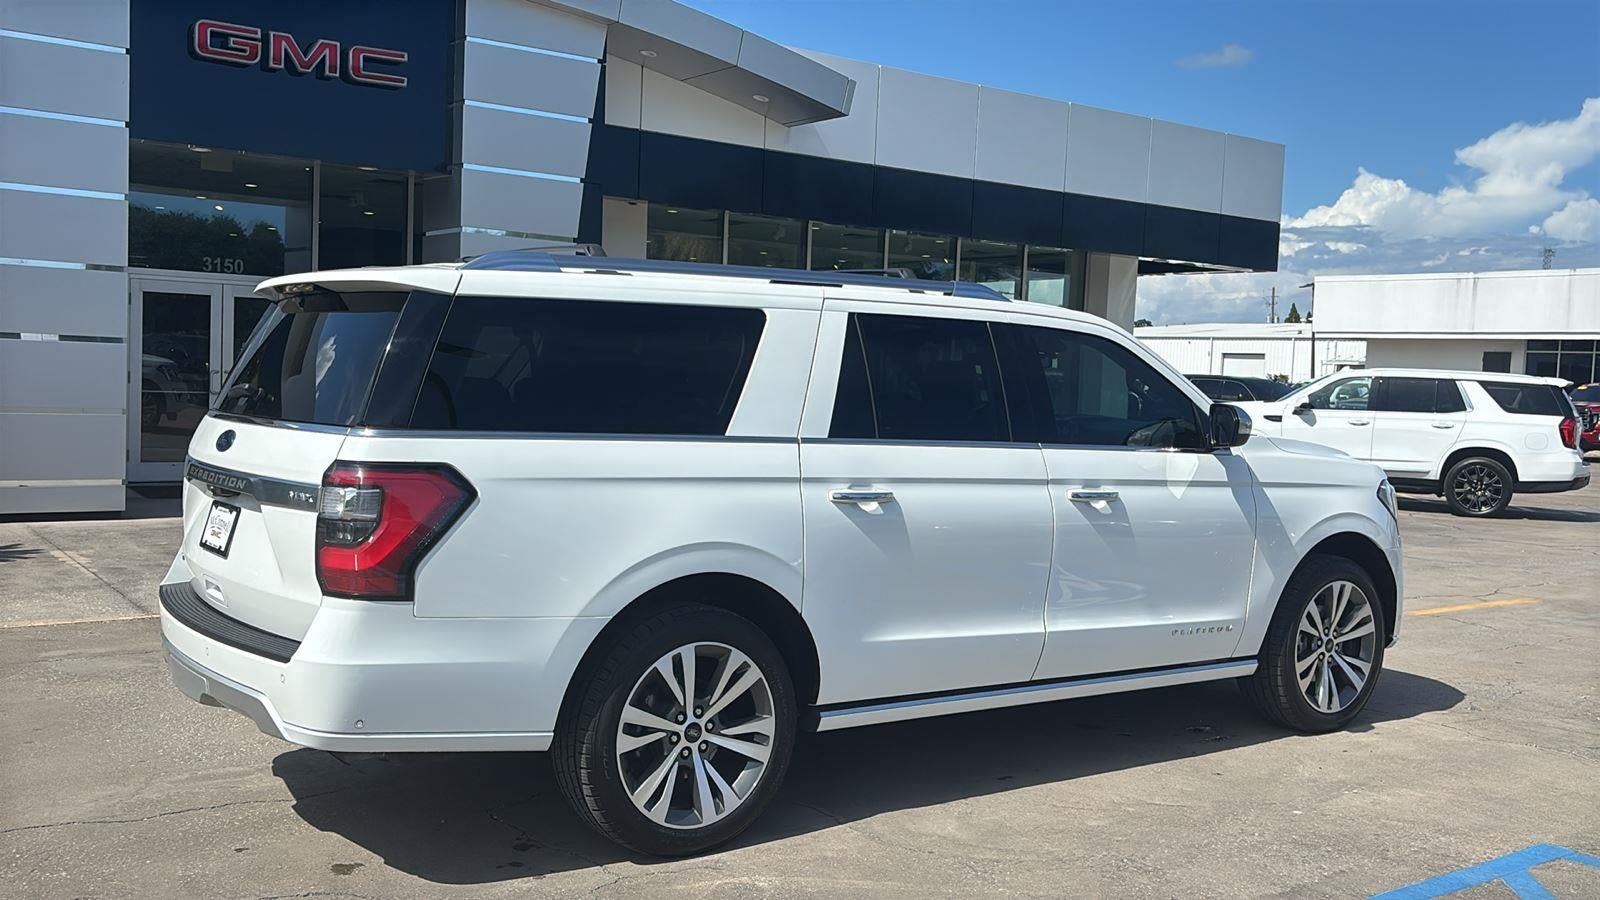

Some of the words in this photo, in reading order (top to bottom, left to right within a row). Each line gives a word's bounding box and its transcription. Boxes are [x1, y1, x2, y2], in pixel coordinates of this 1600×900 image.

[195, 19, 408, 87] GMC
[202, 256, 244, 274] 3150
[189, 465, 247, 490] EXPEDITION
